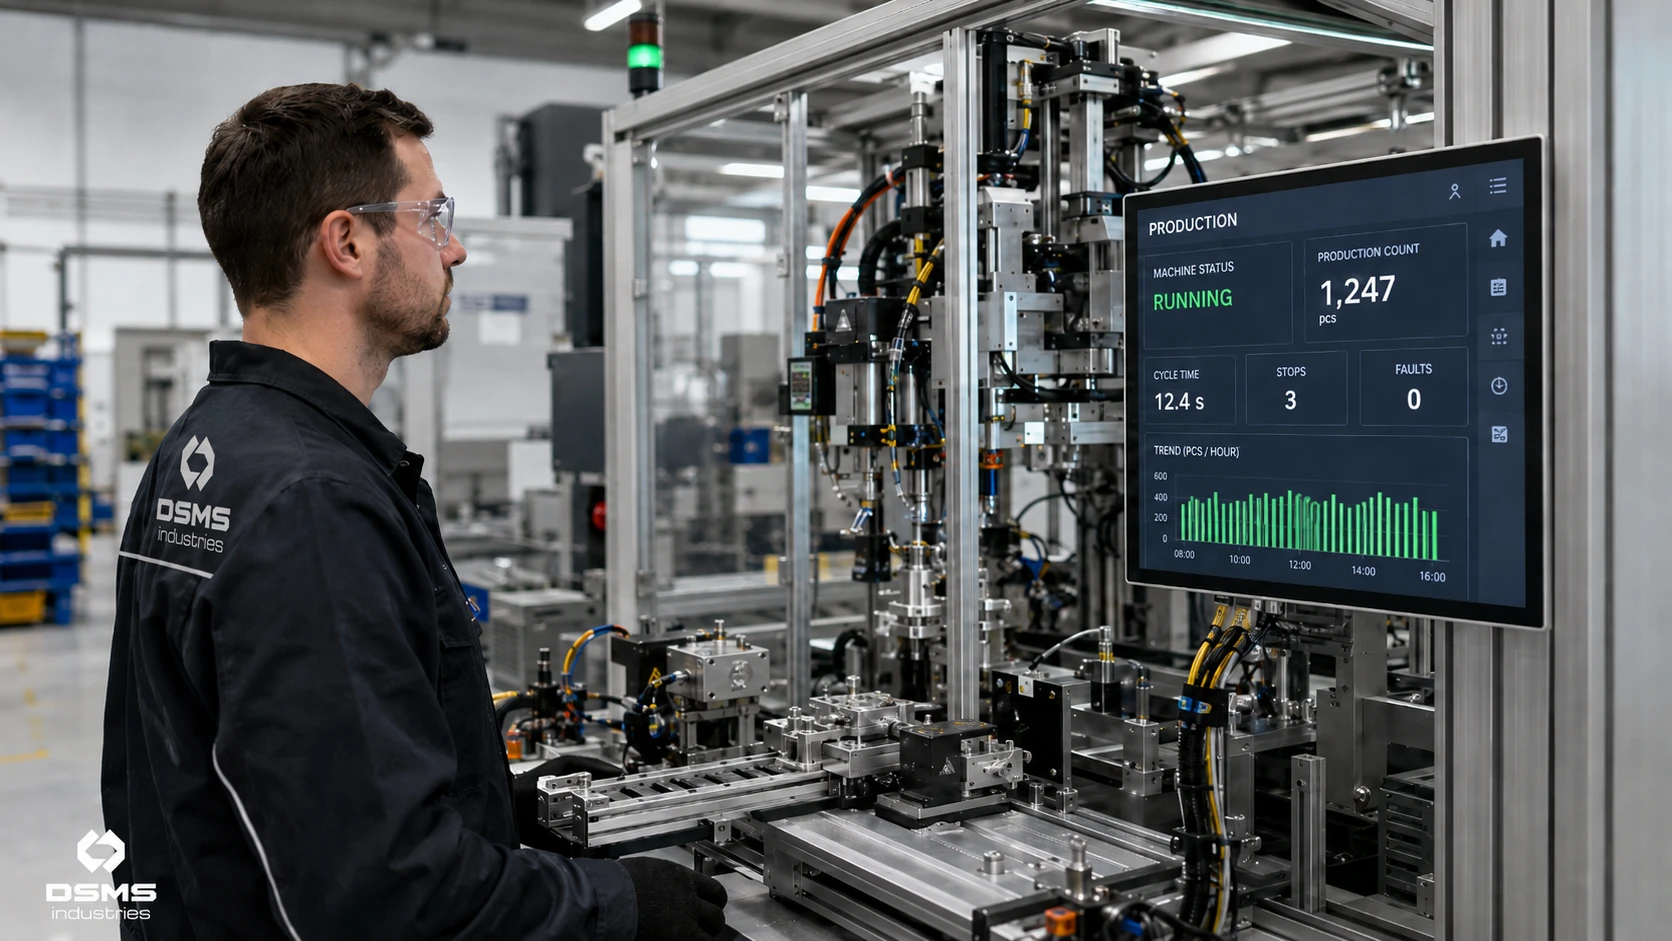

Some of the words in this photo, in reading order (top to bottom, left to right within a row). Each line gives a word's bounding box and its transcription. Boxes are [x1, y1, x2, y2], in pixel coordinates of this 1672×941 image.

[1149, 212, 1238, 236] PRODUCTION
[1318, 247, 1381, 262] PRODUCTION
[1384, 243, 1419, 256] COUNT
[1154, 265, 1196, 278] MACHINE
[1199, 261, 1234, 274] STATUS
[1320, 274, 1396, 310] 1,247
[1154, 289, 1232, 310] RUNNING
[1319, 314, 1337, 326] pcs
[1277, 366, 1307, 377] STOPS
[1396, 363, 1433, 374] FAULTS
[1154, 370, 1179, 380] CYCLE
[1180, 370, 1200, 379] TIME
[1155, 392, 1190, 410] 12.4
[1196, 397, 1204, 410] s
[1285, 390, 1296, 410] 3
[1407, 388, 1421, 410] 0
[1154, 446, 1182, 456] TREND
[1183, 446, 1204, 458] (PCS
[1211, 447, 1240, 459] HOUR)
[1154, 472, 1168, 481] 600
[1154, 493, 1168, 502] 400
[156, 498, 231, 532] DSMS
[1155, 513, 1168, 522] 200
[157, 525, 224, 554] industries
[1162, 534, 1168, 543] 0
[1174, 549, 1195, 560] 08:00
[1230, 555, 1251, 565] 10:00
[1290, 560, 1312, 571] 12:00
[1352, 566, 1377, 577] 14:00
[1420, 571, 1446, 583] 16:00
